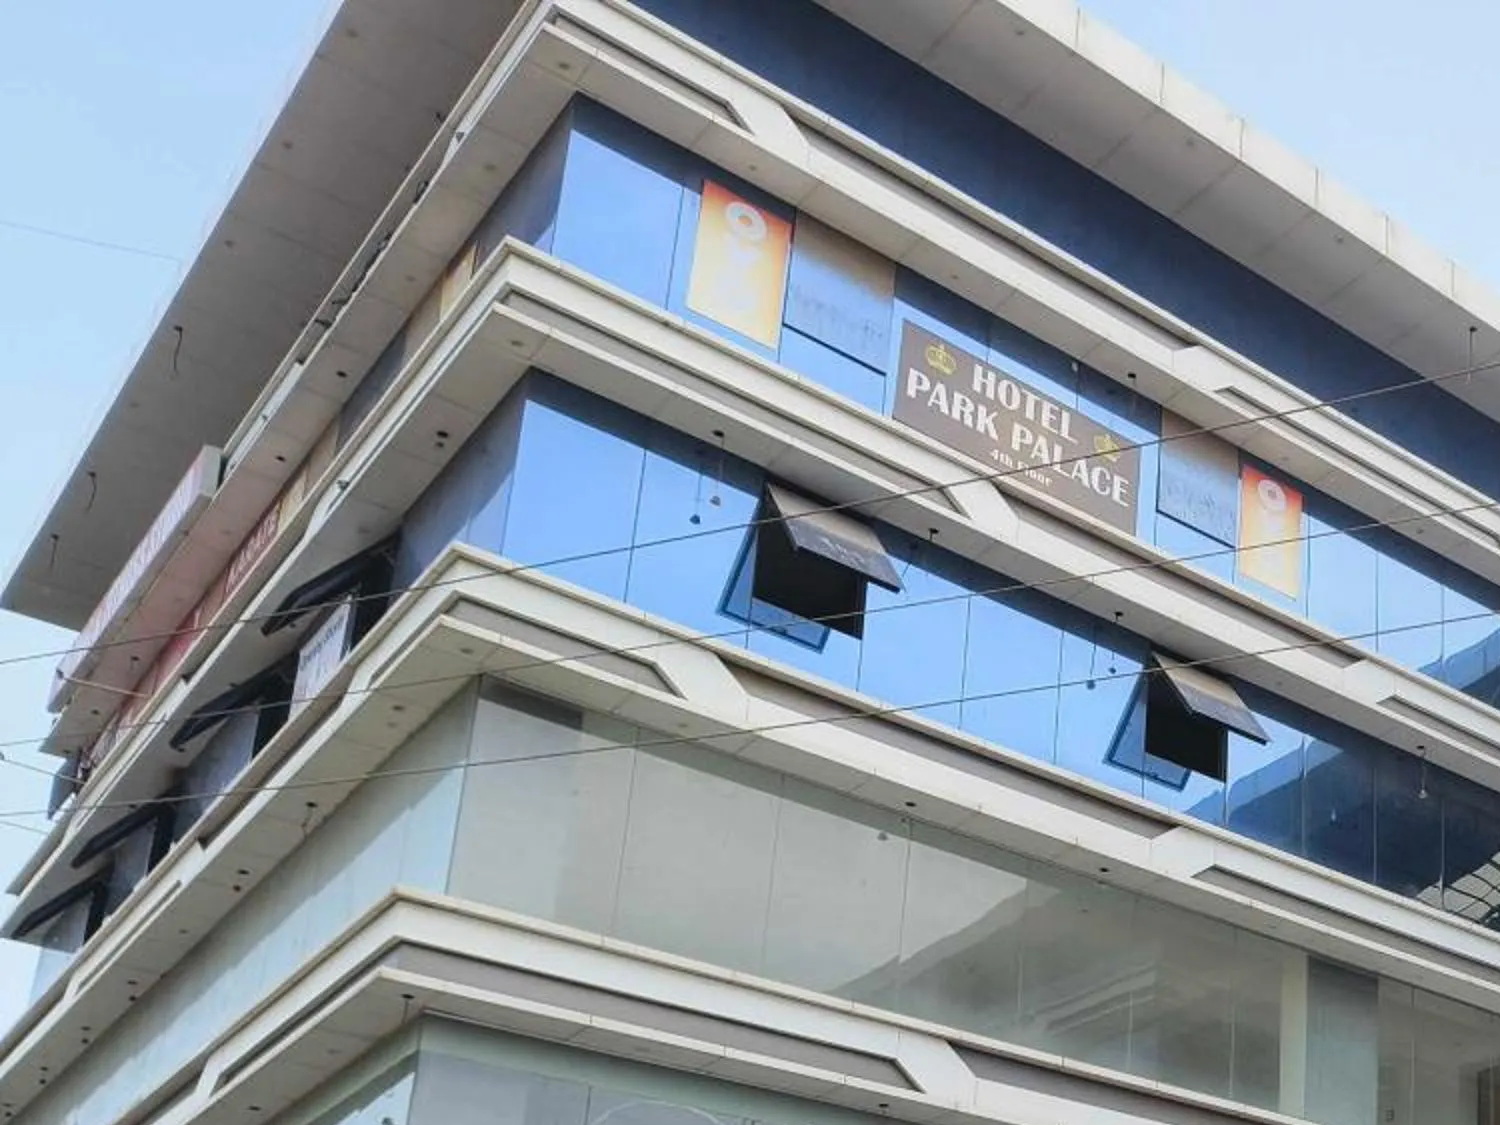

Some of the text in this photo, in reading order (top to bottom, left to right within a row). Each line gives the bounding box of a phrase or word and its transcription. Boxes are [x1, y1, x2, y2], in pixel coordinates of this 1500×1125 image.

[907, 367, 1129, 507] PARK PALACE
[971, 363, 1080, 444] HOTEL
